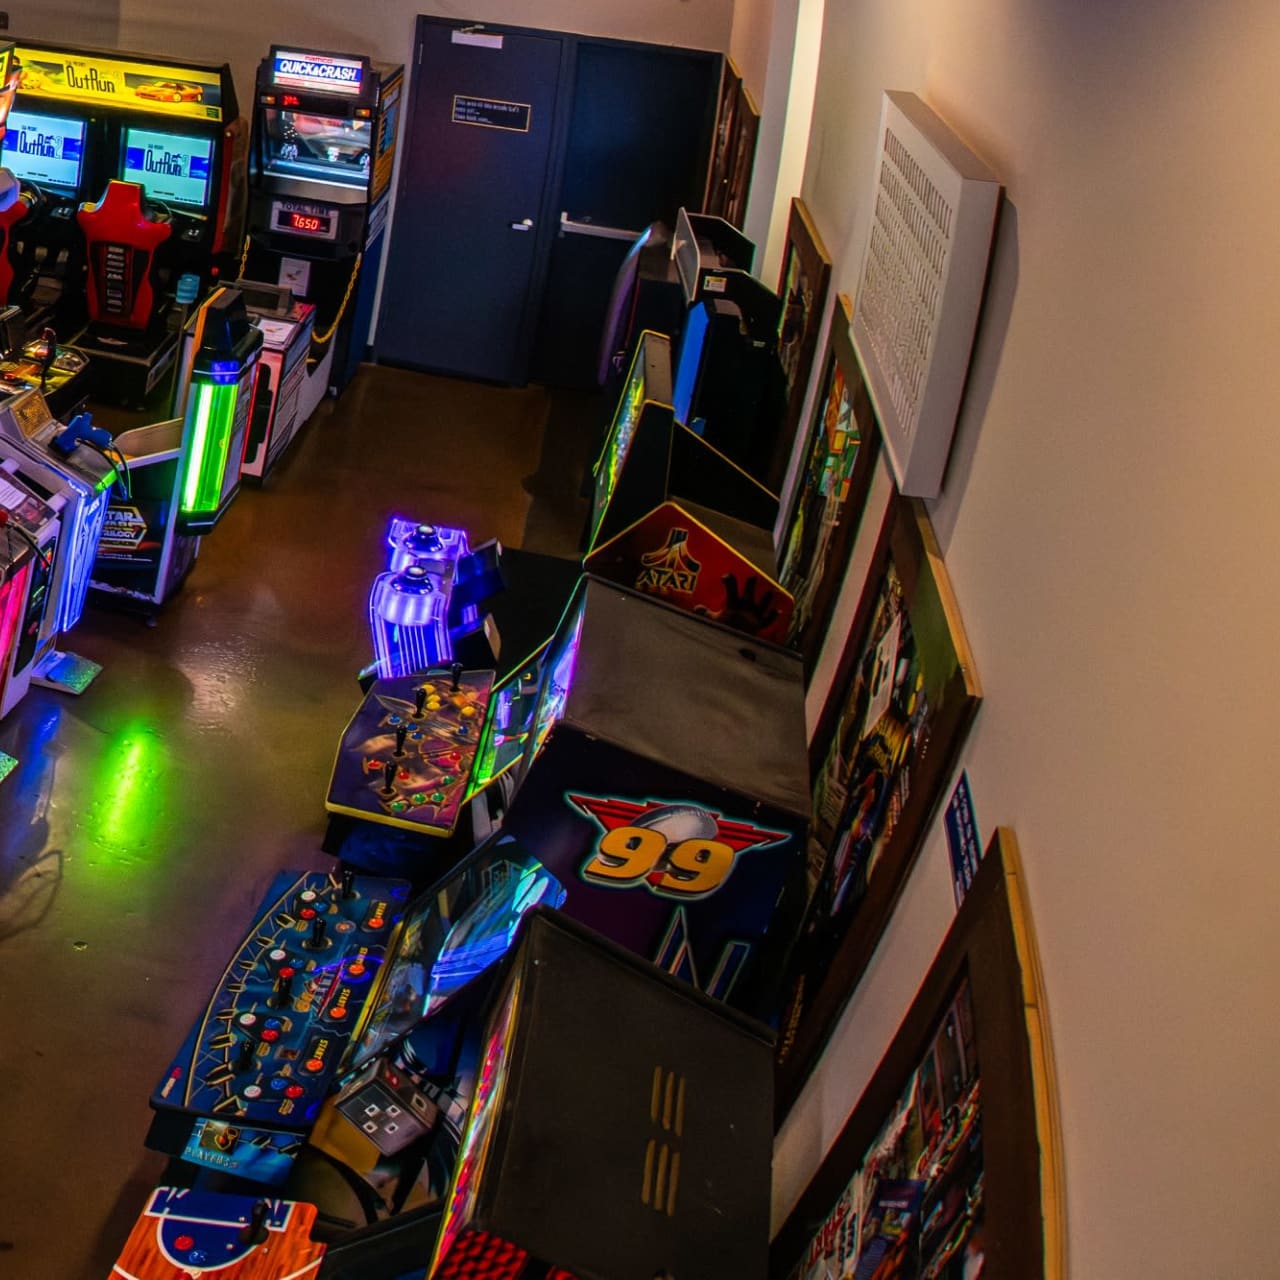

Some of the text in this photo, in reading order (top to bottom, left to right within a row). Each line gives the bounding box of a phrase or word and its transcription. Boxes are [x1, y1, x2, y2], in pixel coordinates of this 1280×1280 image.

[66, 65, 115, 93] OutRun
[584, 826, 737, 900] 99
[313, 1039, 329, 1061] START
